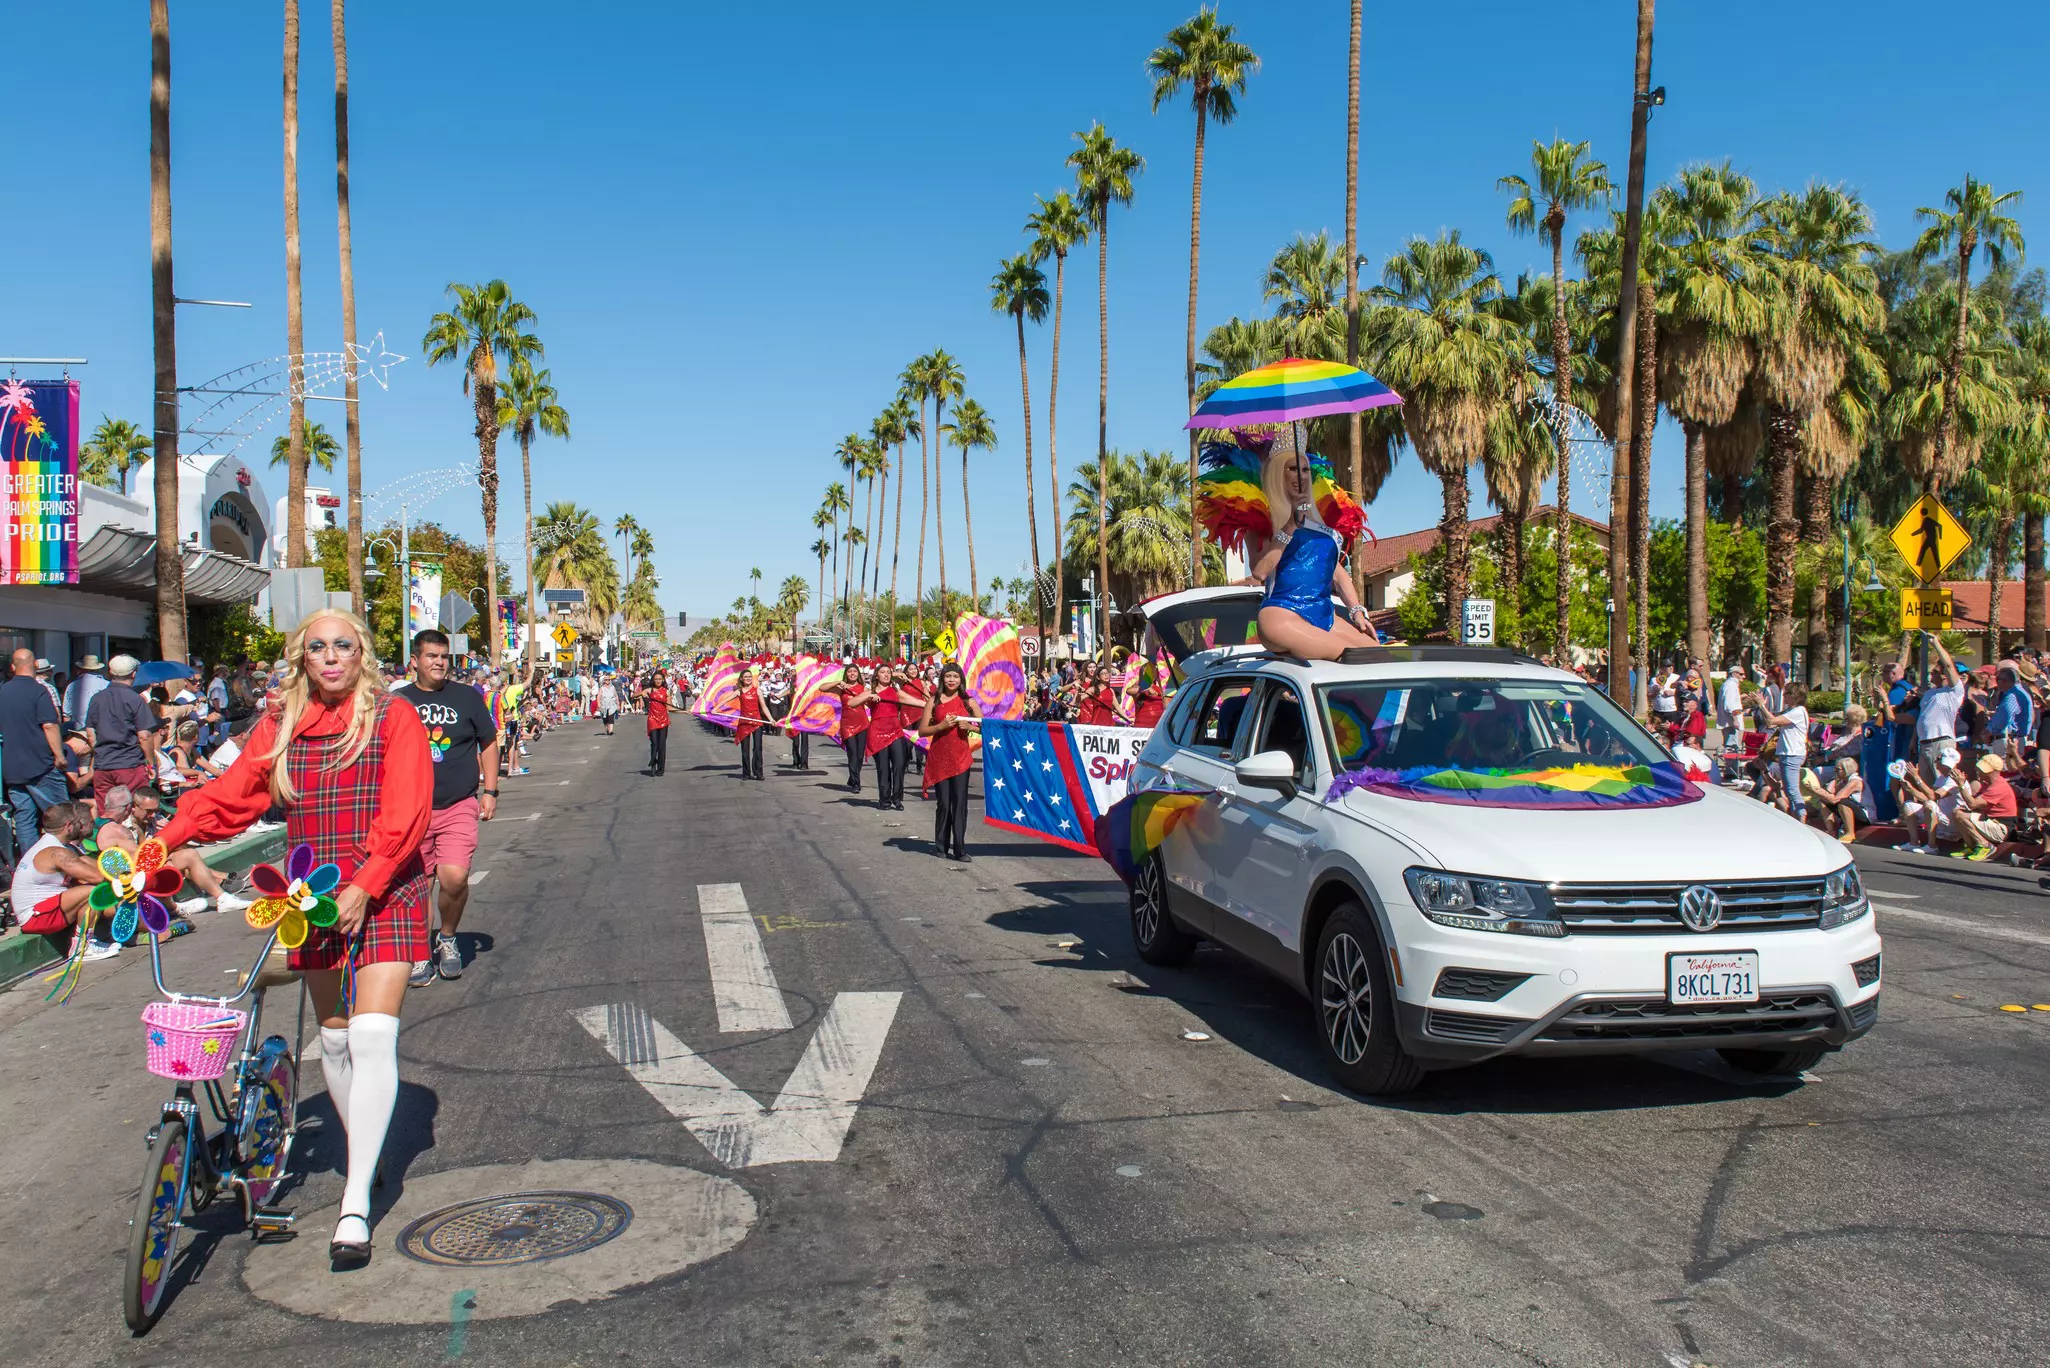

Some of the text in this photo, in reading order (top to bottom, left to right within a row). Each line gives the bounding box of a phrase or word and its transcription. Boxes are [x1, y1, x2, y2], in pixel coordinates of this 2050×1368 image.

[3, 474, 75, 494] GREATER
[3, 500, 76, 516] PALM SPRINGS
[4, 523, 76, 542] PRIDE
[15, 572, 65, 582] PSPRIDE.ORG
[1905, 601, 1949, 617] AHEAD
[1464, 623, 1491, 638] 35
[1082, 734, 1120, 755] PALM
[1688, 958, 1743, 973] California
[1677, 973, 1754, 997] 8KCL731
